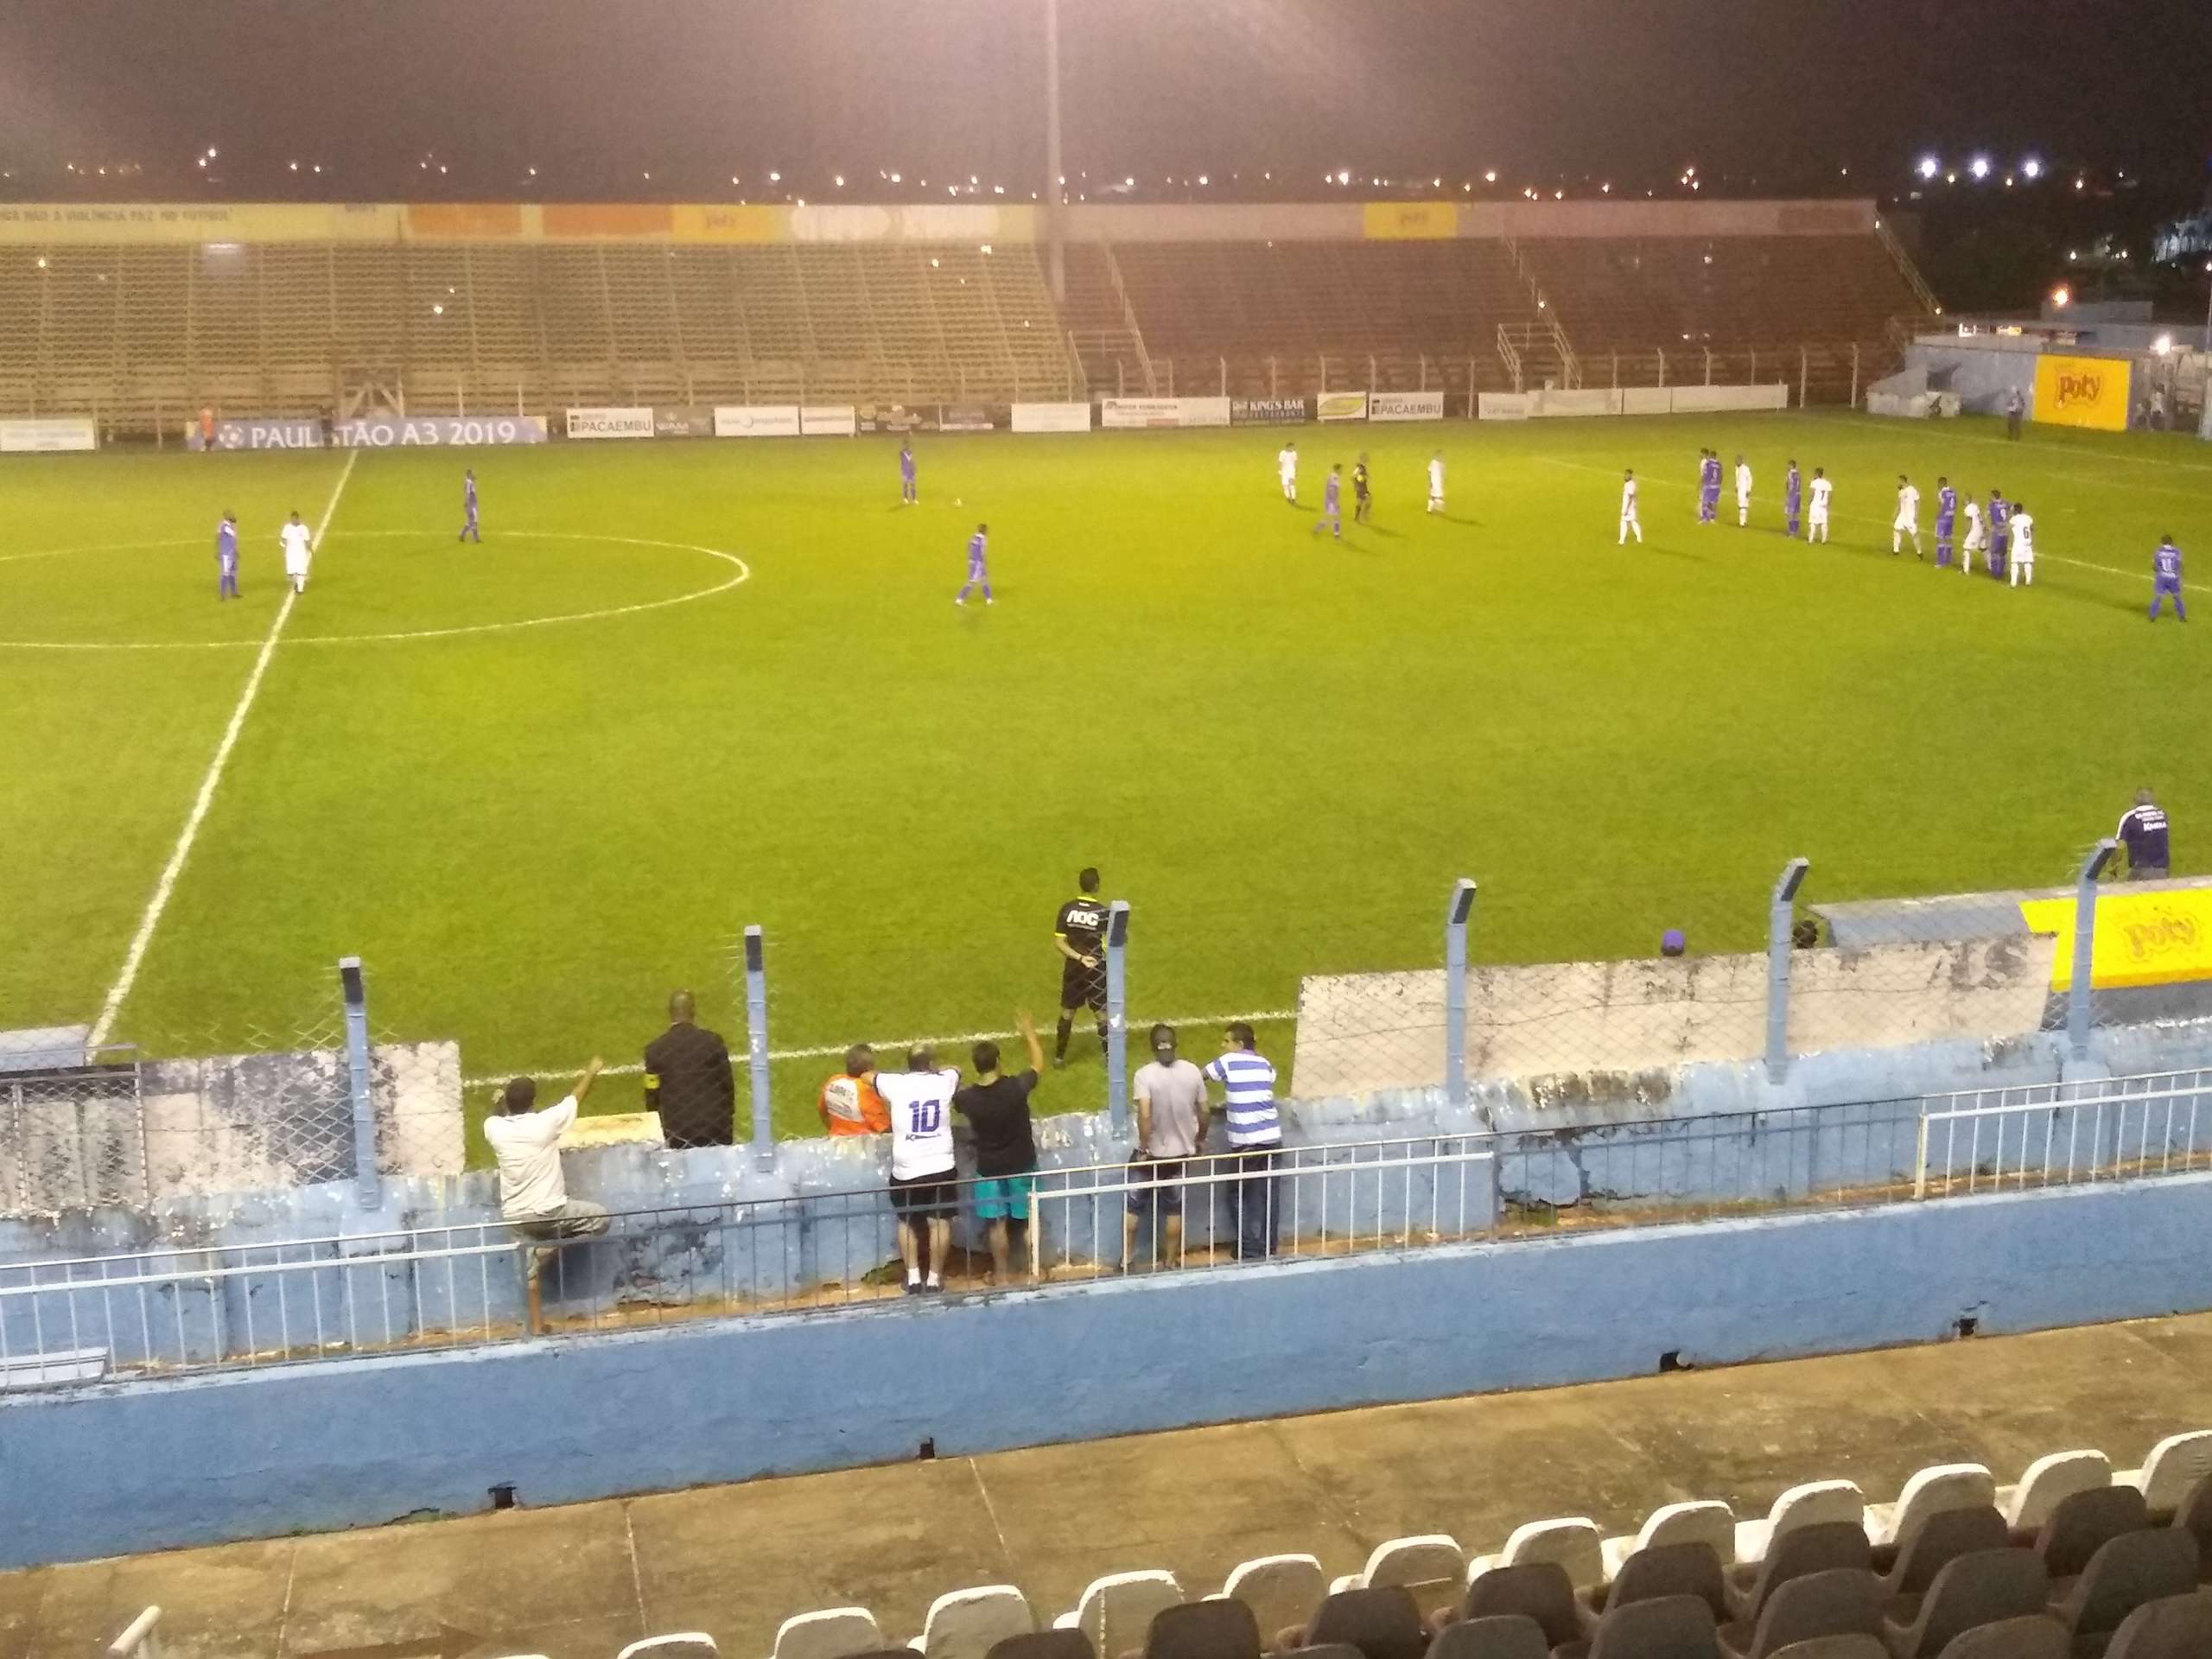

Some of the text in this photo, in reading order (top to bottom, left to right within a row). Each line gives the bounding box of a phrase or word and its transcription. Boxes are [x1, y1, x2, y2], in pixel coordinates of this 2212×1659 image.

[1382, 403, 1441, 416] PACAEMBU
[251, 421, 516, 448] PAULTÃO A3 2019
[581, 420, 651, 431] PACAEMBU
[909, 1099, 941, 1133] 10
